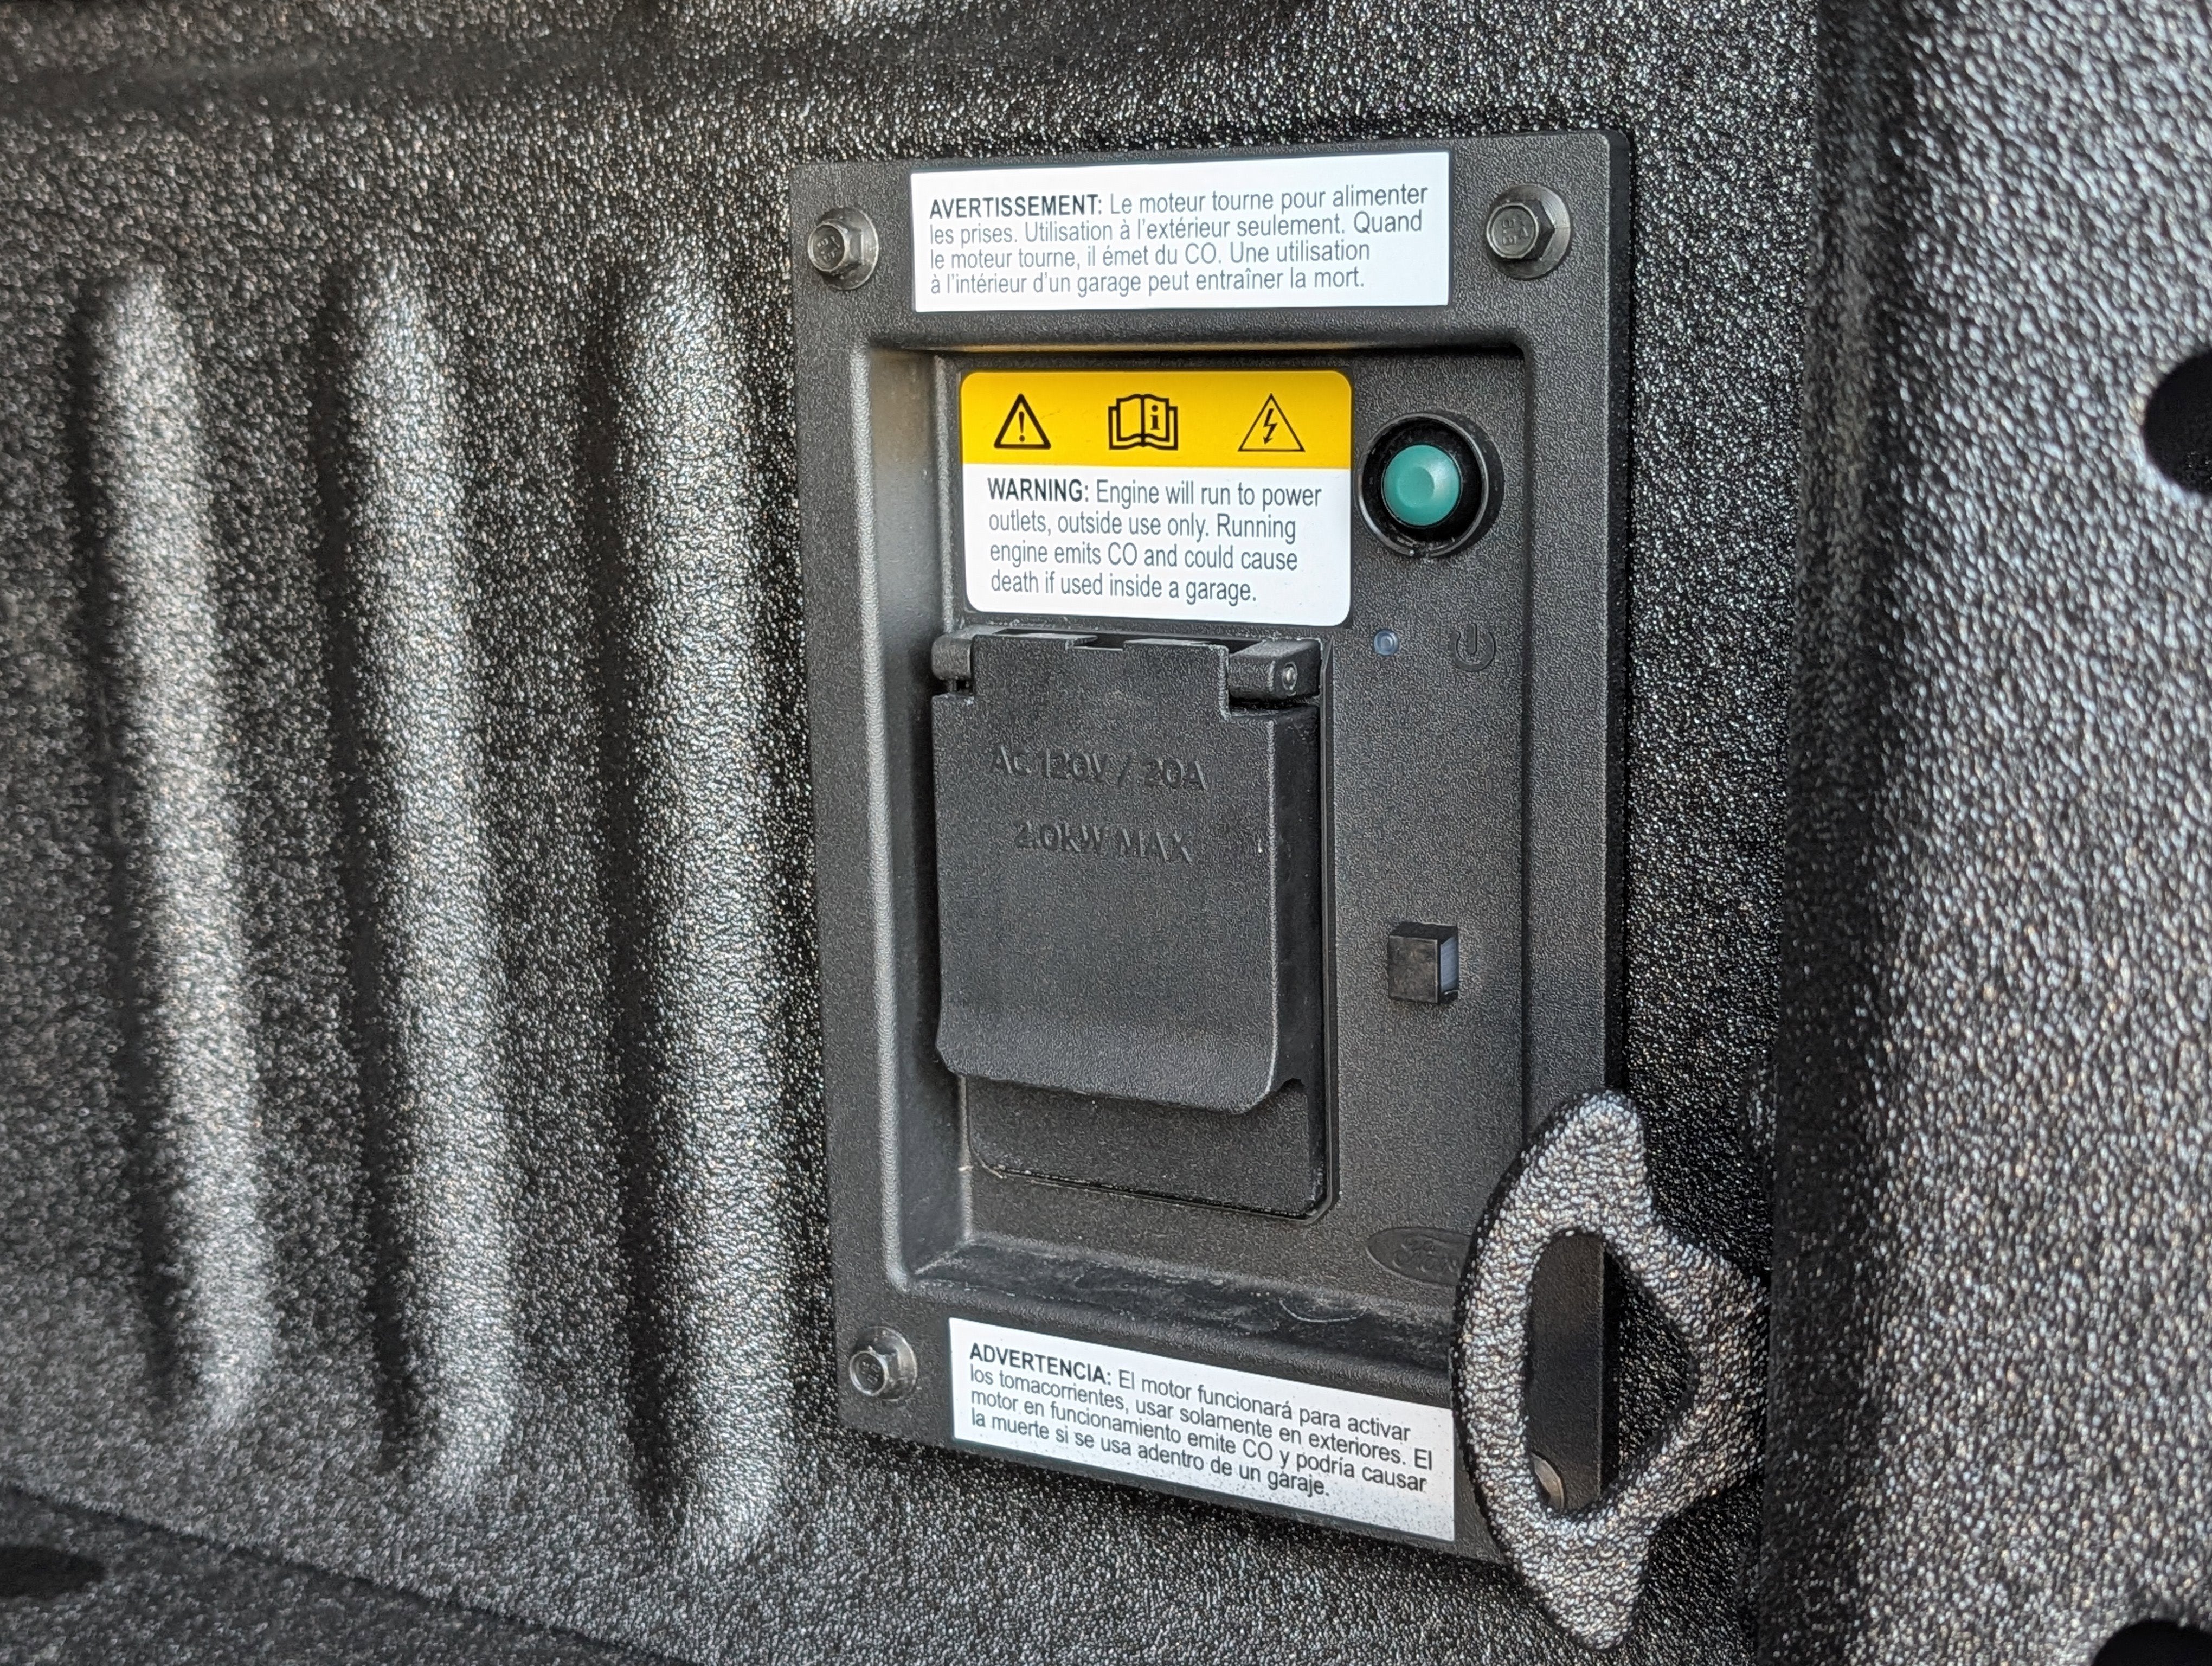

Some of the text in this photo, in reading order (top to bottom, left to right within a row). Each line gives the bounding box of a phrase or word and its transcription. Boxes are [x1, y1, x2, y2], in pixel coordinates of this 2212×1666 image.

[929, 183, 1429, 220] AVERTISSEMENT: Le moteur tourne pour alimenter
[929, 224, 954, 245] les
[960, 223, 1020, 249] prises.
[1025, 221, 1113, 243] Utilisation
[1120, 218, 1130, 240] à
[1237, 213, 1345, 238] seulement.
[1353, 208, 1423, 235] Quand
[930, 238, 1370, 270] le moteur tourne, il émet du CO. Une utilisation
[930, 272, 941, 295] à
[1077, 275, 1142, 298] garage
[1148, 270, 1189, 297] peut
[1195, 267, 1284, 291] entraîner
[1290, 266, 1307, 289] la
[1314, 266, 1365, 289] mort.
[986, 477, 1323, 513] WARNING: Engine will run to power
[988, 508, 1296, 546] outlets, outside use only. Running
[989, 539, 1298, 572] engine emits CO and could cause
[991, 568, 1257, 607] death if used inside a garage.
[992, 745, 1031, 777] AC
[1039, 747, 1108, 783] 120V
[1143, 757, 1208, 791] 20A
[1119, 827, 1193, 865] MAX
[969, 1342, 1412, 1443] ADVERTENCIA: El motor funcionará para activar
[970, 1363, 1433, 1471] los tomacorrientes, usar solamente en exteriores. El
[970, 1389, 1428, 1493] motor en funcionamiento emite CO y podría causar
[971, 1407, 1330, 1498] la muerte si se usa adentro de un garaje.
